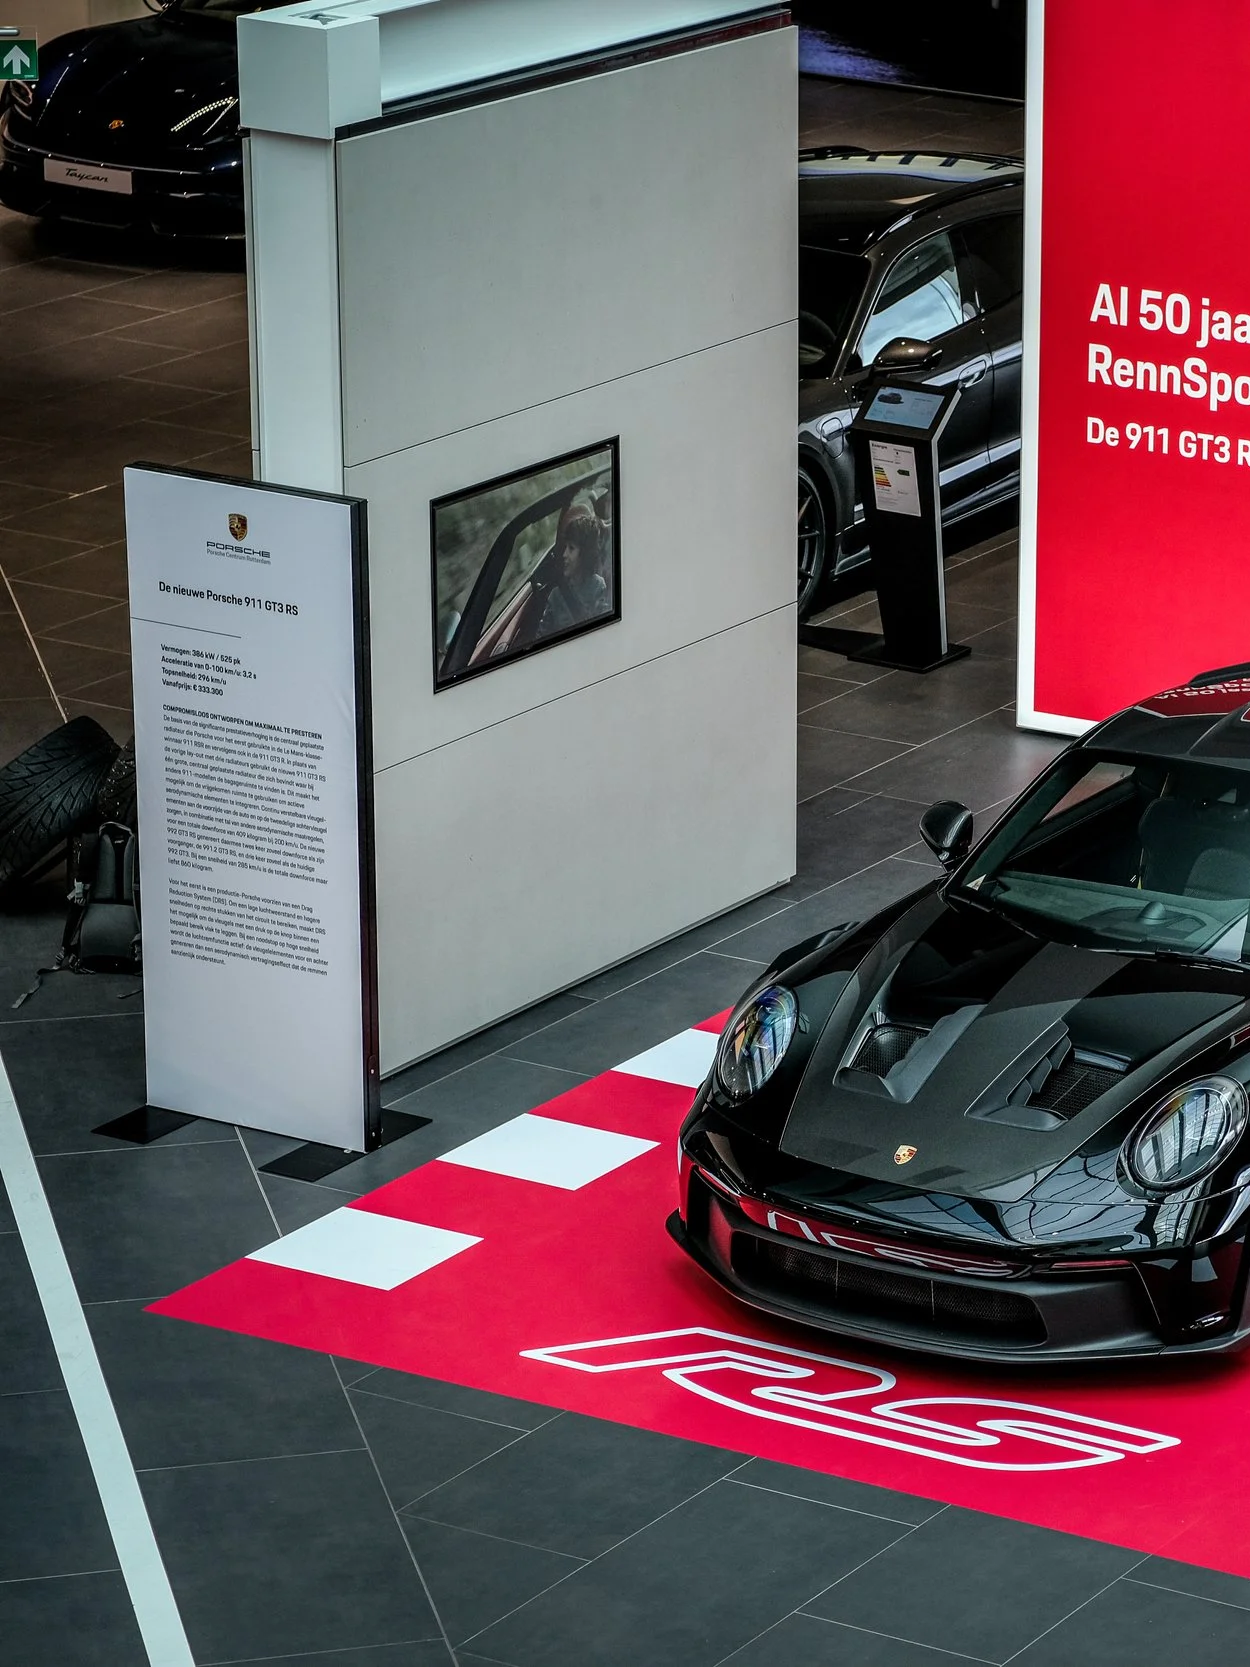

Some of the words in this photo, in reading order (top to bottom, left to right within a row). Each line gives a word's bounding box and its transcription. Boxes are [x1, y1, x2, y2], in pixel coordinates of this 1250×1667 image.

[65, 167, 108, 182] Taycan
[1090, 283, 1129, 327] Al
[1139, 288, 1191, 335] 50
[1086, 416, 1119, 447] De
[1125, 422, 1169, 454] 911
[1178, 431, 1231, 464] GT3
[207, 541, 271, 558] PORSCHE
[207, 549, 225, 557] Porsche
[159, 581, 171, 593] De
[173, 585, 204, 599] nieuwe
[207, 590, 243, 606] Porsche
[244, 597, 262, 609] 911
[265, 600, 284, 613] GT3
[286, 604, 299, 616] RS
[161, 644, 191, 656] Vermogen:
[192, 649, 204, 658] 386
[205, 651, 215, 660] kW
[220, 655, 232, 663] 525
[161, 655, 193, 667] Acceleratie
[205, 663, 223, 673] 0-100
[224, 667, 241, 677] km/u:
[242, 670, 252, 679] 3,2
[161, 667, 197, 680] Topsnelheid:
[198, 674, 210, 682] 296
[210, 676, 227, 685] km/u
[162, 678, 192, 691] Vanafprijs:
[163, 704, 210, 719] COMPROMISLOOS
[210, 713, 244, 725] ONTWORPEN
[254, 722, 284, 733] MAXIMAAL
[291, 729, 322, 740] PRESTEREN
[519, 1326, 1182, 1471] RS
